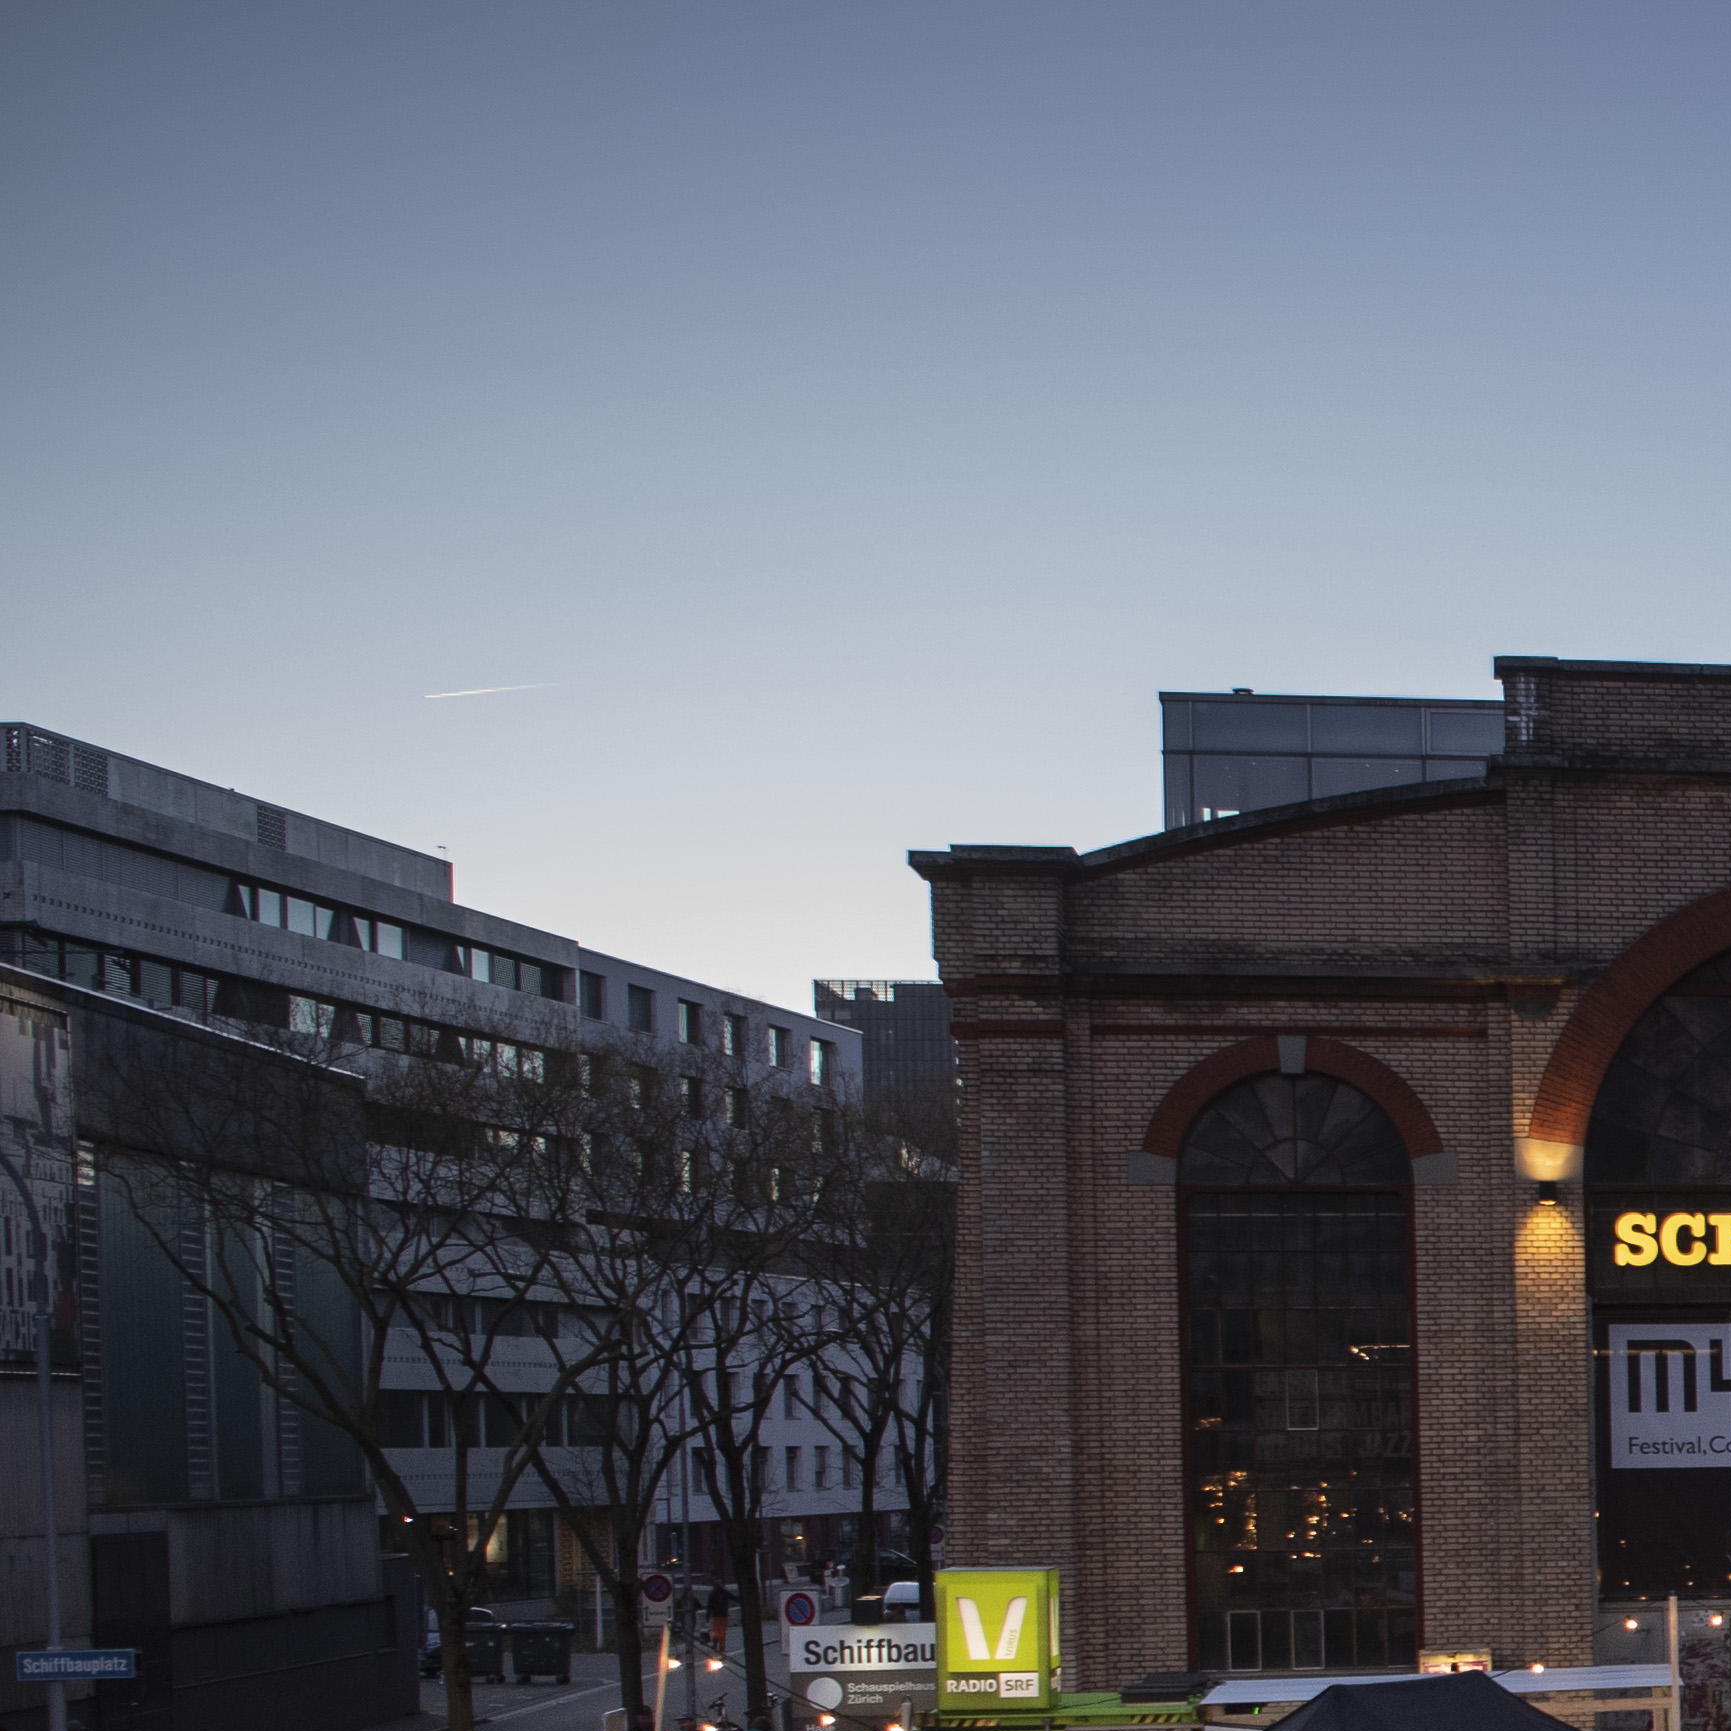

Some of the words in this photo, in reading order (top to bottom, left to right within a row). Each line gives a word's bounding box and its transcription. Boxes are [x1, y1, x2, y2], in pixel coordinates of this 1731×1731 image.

[804, 1638, 936, 1666] Schiffbau
[22, 1657, 129, 1674] Schiffbauplatz
[847, 1681, 936, 1694] Schauspielhaus
[946, 1679, 998, 1693] RADIO
[1004, 1679, 1034, 1692] SRF
[847, 1694, 884, 1705] Zürich
